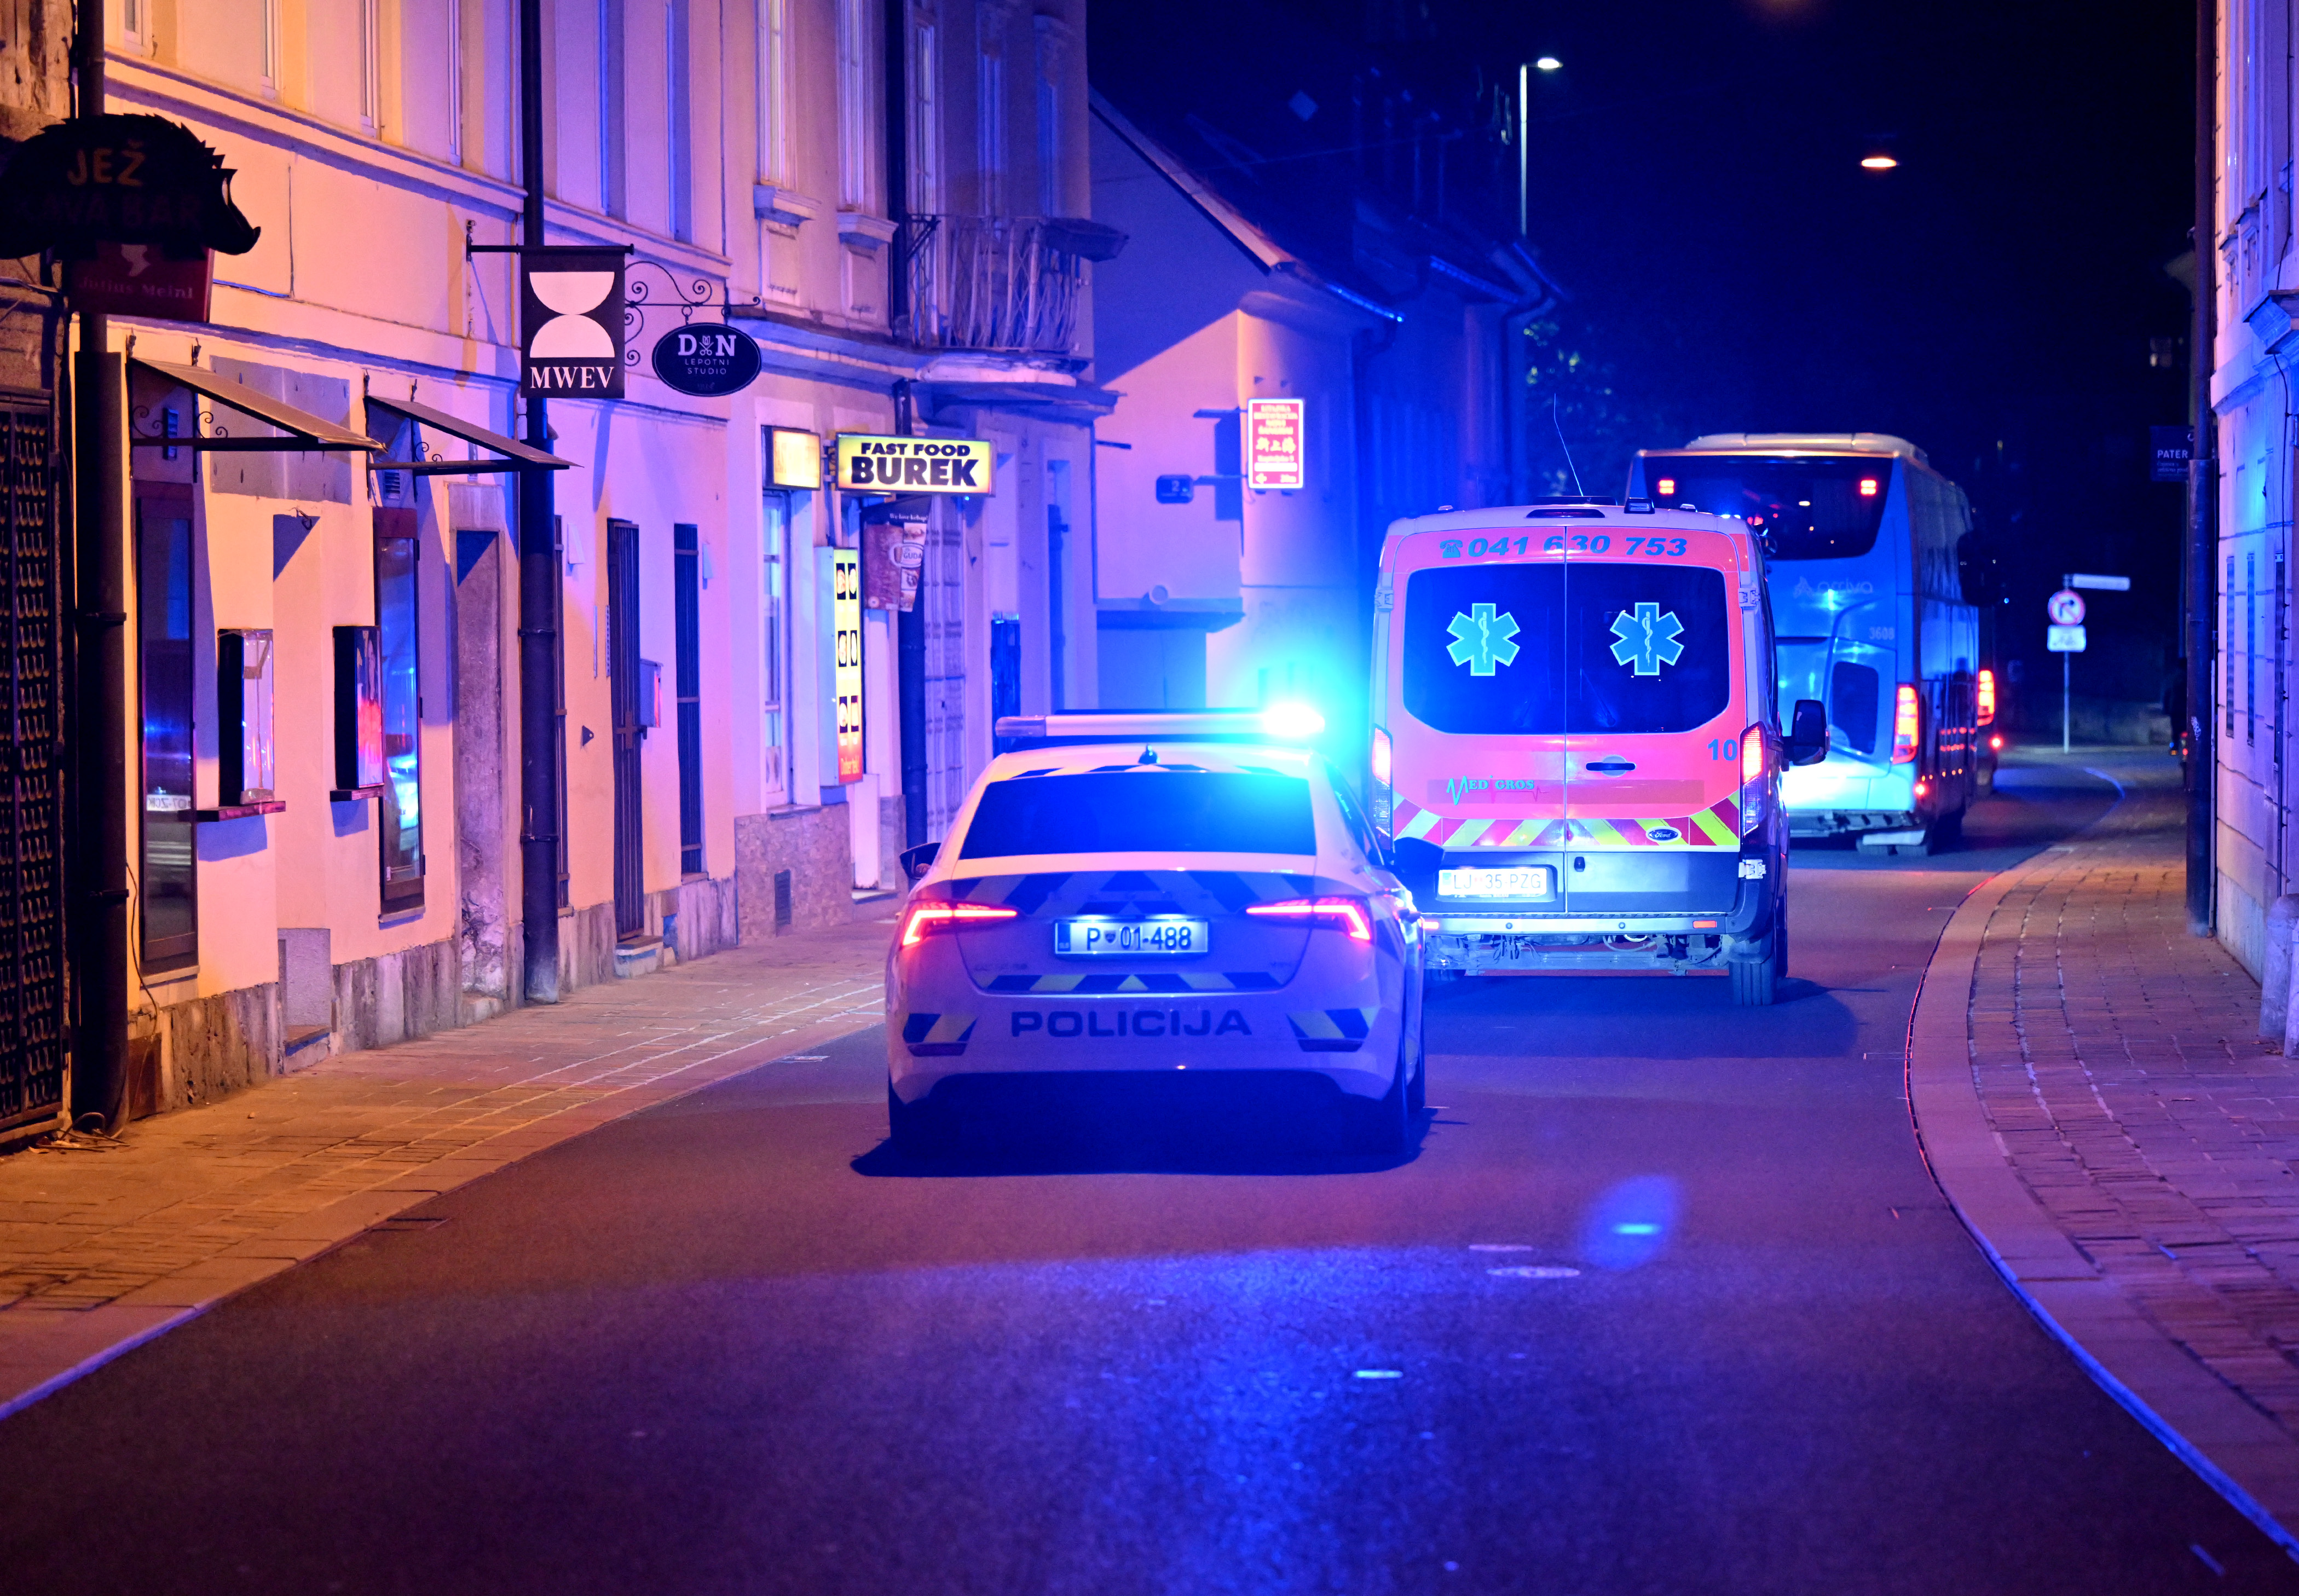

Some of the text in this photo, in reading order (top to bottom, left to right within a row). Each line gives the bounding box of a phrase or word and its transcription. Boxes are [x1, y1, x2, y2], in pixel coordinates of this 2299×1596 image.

[67, 139, 146, 187] JEŽ
[141, 282, 193, 299] Meinl
[530, 366, 615, 389] MWEV
[861, 442, 971, 456] FAST FOOD
[2157, 449, 2188, 459] PATER
[851, 456, 979, 487] BUREK
[1468, 535, 1688, 558] 041 630 753
[1869, 627, 1896, 640] 3608
[1707, 739, 1737, 761] 10
[1446, 776, 1534, 805] MED GROS
[1454, 874, 1541, 889] LJ 35-PZG
[1087, 926, 1191, 951] P 01-488
[1011, 1009, 1252, 1038] POLICIJA
